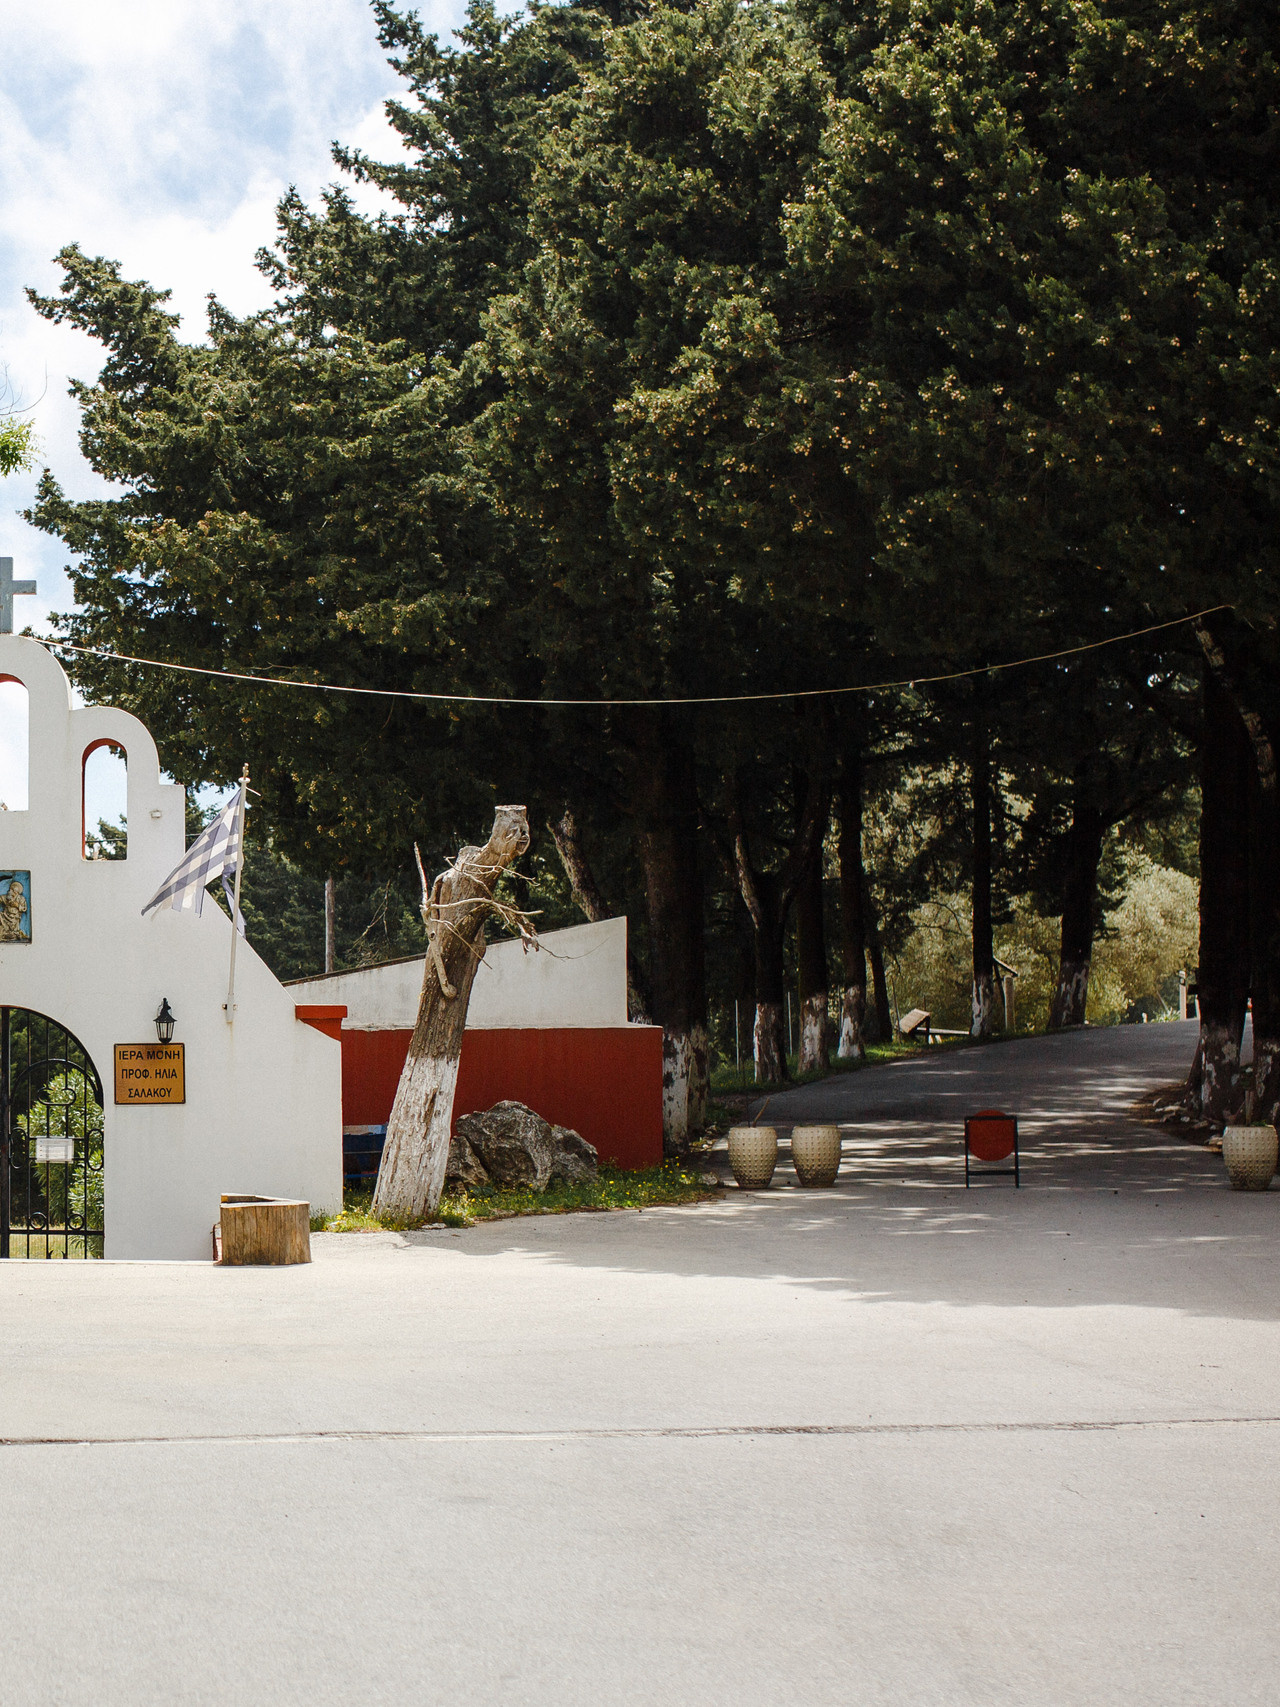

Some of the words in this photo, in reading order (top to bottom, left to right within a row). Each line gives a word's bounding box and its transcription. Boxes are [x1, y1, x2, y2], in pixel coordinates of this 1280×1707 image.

[118, 1050, 144, 1060] ΙΕΡΑ
[146, 1050, 180, 1060] ΜΟΝΗ
[121, 1068, 153, 1079] ΠΡΟΦ.
[154, 1068, 178, 1079] ΗΛΙΑ
[128, 1087, 172, 1098] ΣΑΛΑΚΟΥ
